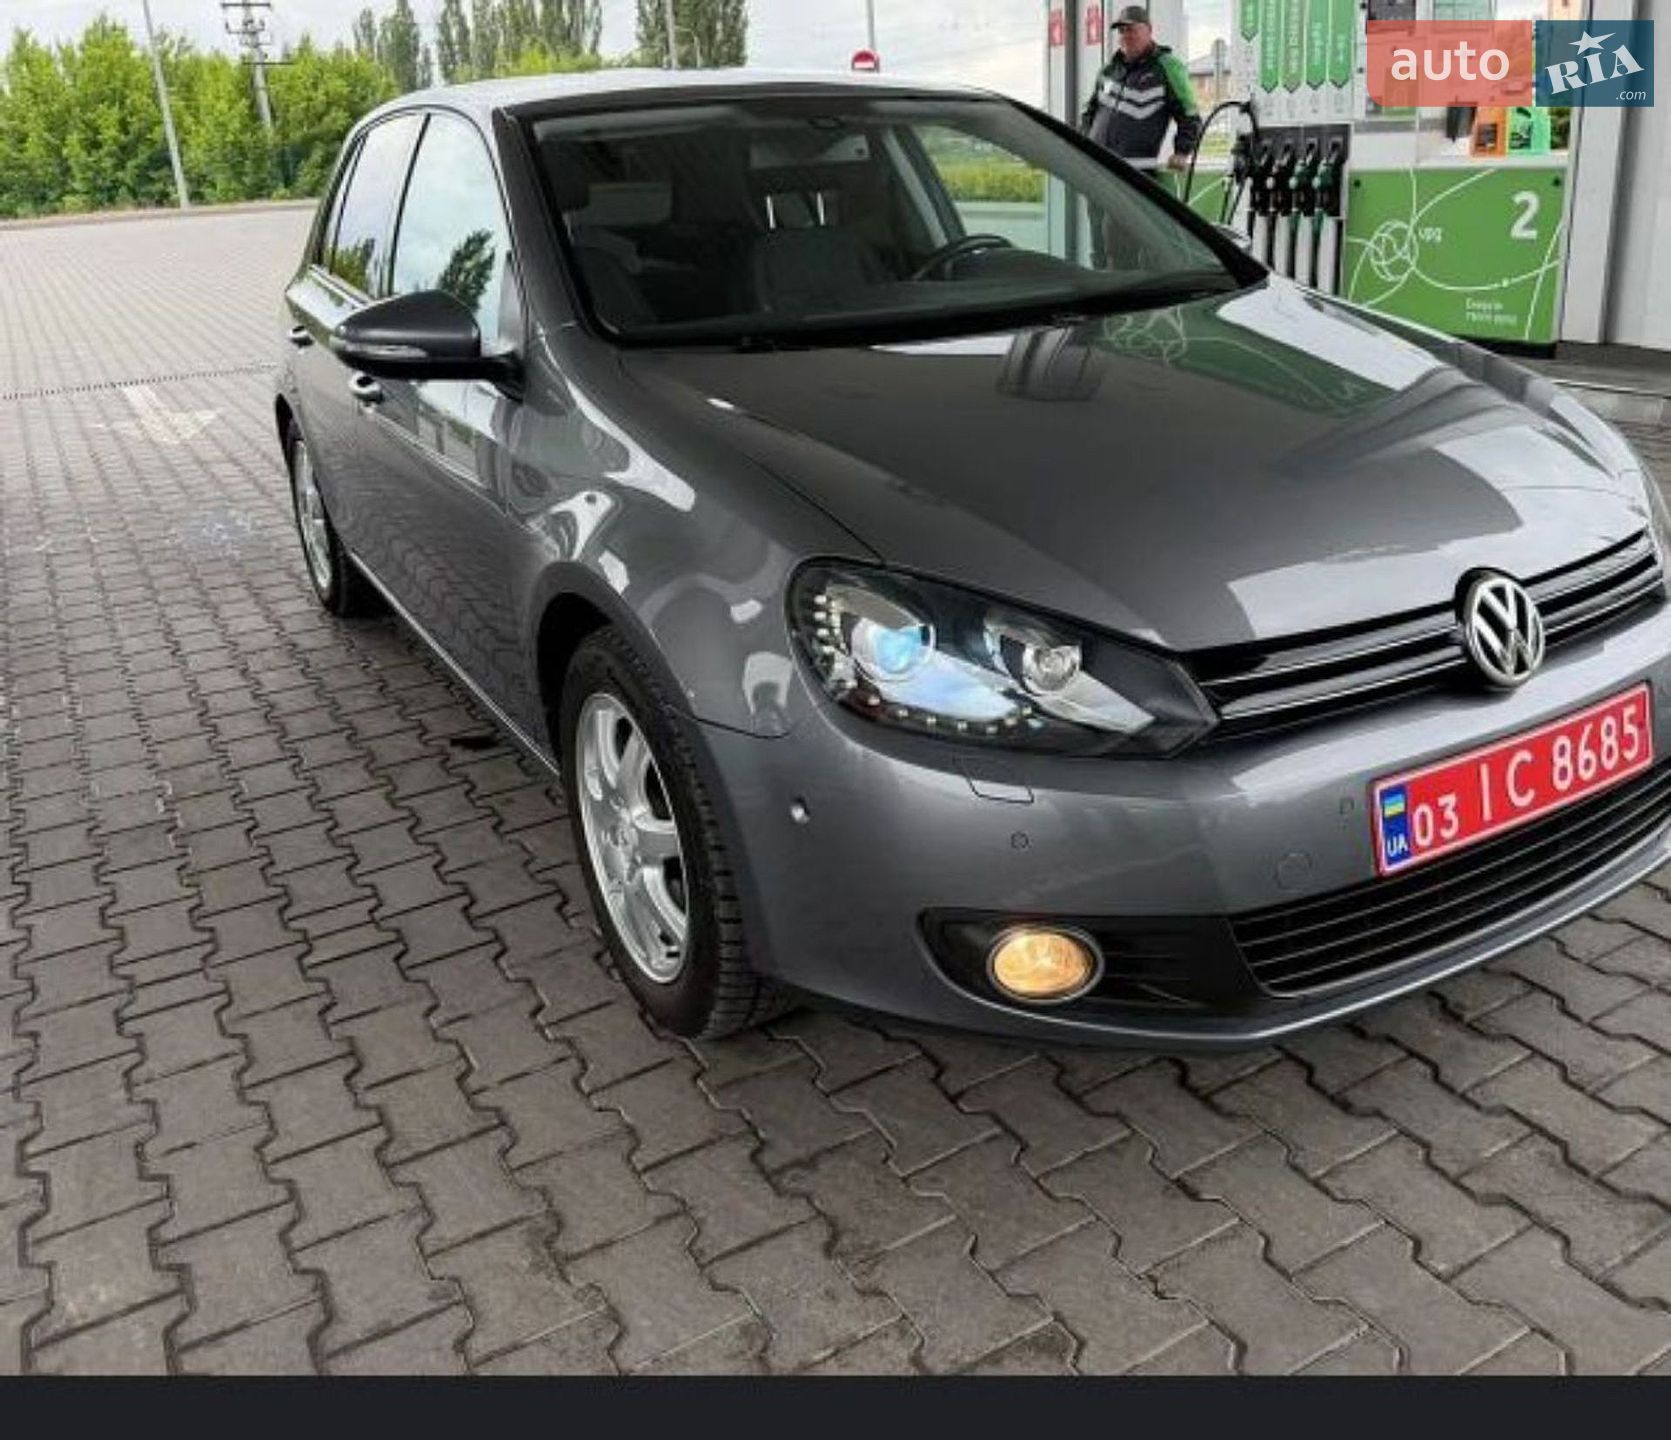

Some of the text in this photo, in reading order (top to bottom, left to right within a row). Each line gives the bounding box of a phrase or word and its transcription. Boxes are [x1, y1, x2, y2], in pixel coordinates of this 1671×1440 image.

[1510, 190, 1539, 240] 2
[1412, 794, 1459, 847] 03
[1552, 704, 1639, 790] 8685
[1386, 834, 1409, 857] UA
